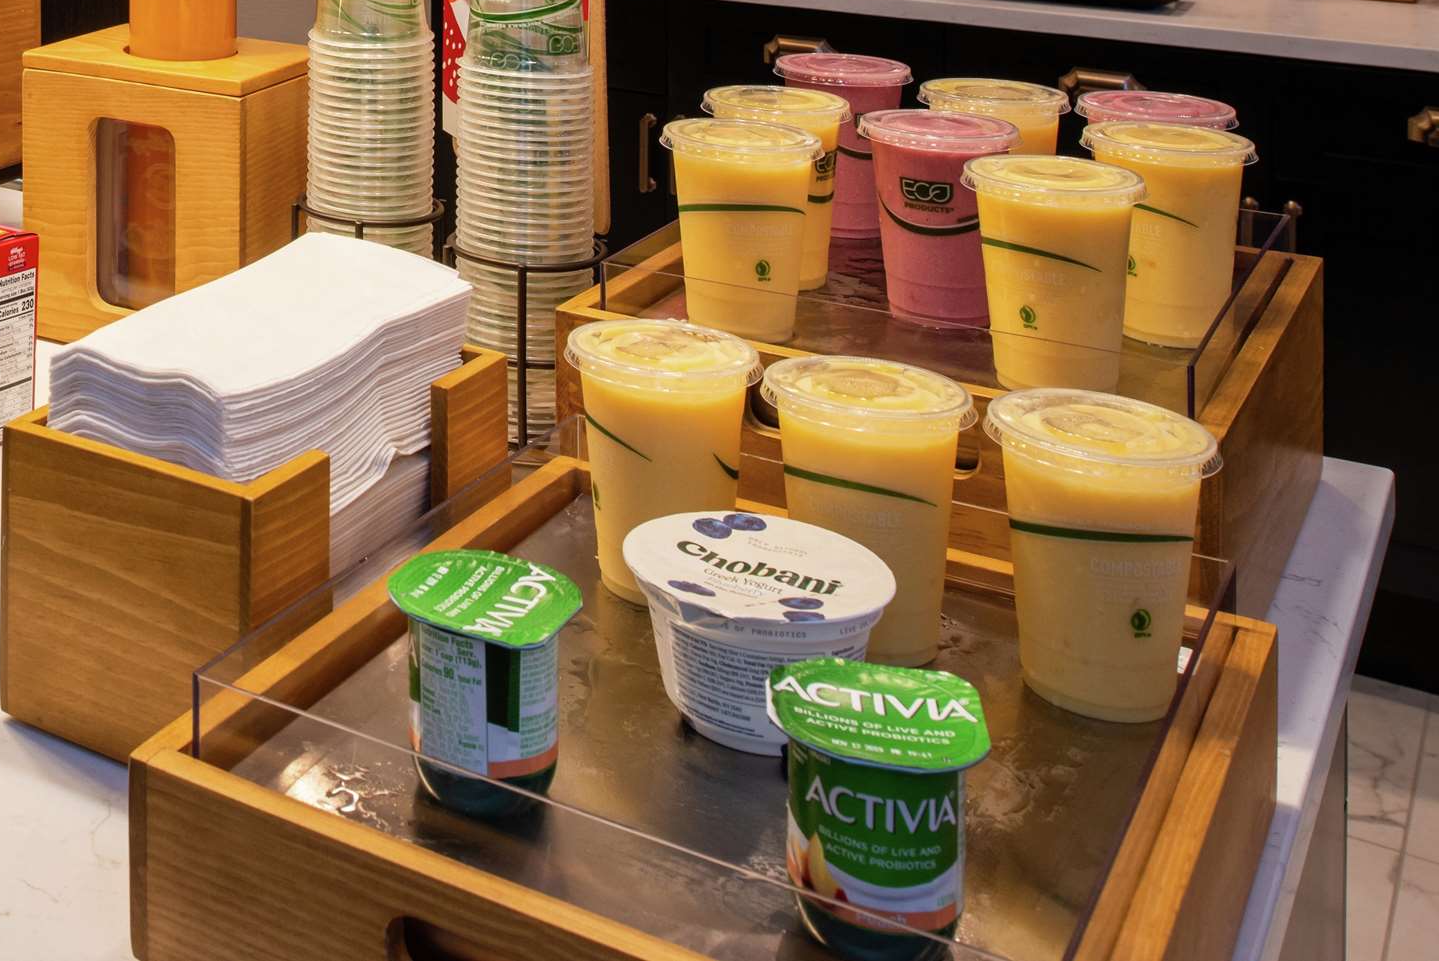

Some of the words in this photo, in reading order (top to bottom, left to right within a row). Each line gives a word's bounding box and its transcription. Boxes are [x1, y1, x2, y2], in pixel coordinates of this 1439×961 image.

[21, 299, 34, 312] 230
[676, 540, 843, 596] Chobani
[704, 567, 738, 584] Greek
[743, 577, 783, 595] Yogurt
[463, 563, 557, 637] ACTIVIA
[751, 628, 807, 638] PROBIOTICS
[772, 676, 979, 724] ACTIVIA
[794, 706, 859, 727] BILLIONS
[863, 721, 883, 730] OF
[887, 724, 920, 736] LIVE
[923, 730, 956, 738] AND
[806, 717, 858, 734] ACTIVE
[861, 729, 951, 745] PROBIOTICS
[805, 775, 957, 834] ACTIVIA
[818, 824, 869, 852] BILLIONS
[871, 844, 888, 855] OF
[891, 847, 917, 858] LIVE
[919, 845, 942, 857] AND
[825, 843, 865, 865] ACTIVE
[869, 857, 937, 871] PROBIOTICS
